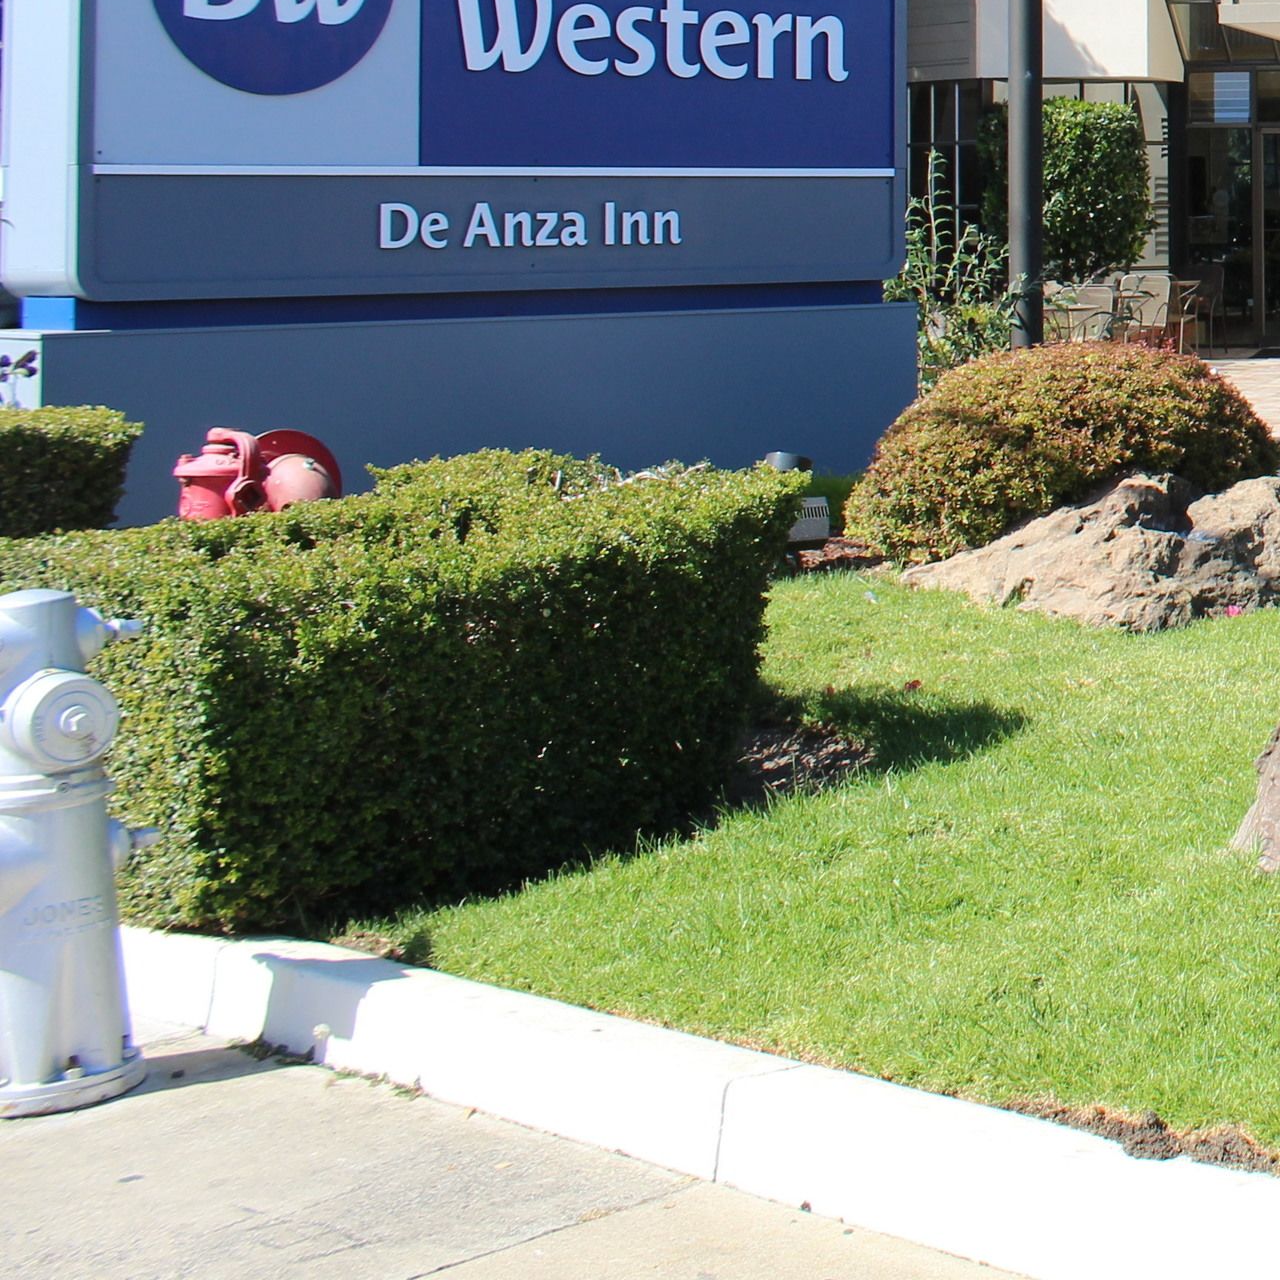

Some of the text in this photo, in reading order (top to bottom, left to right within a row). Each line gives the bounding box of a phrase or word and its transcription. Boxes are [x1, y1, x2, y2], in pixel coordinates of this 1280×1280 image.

[379, 201, 682, 249] De Anza Inn
